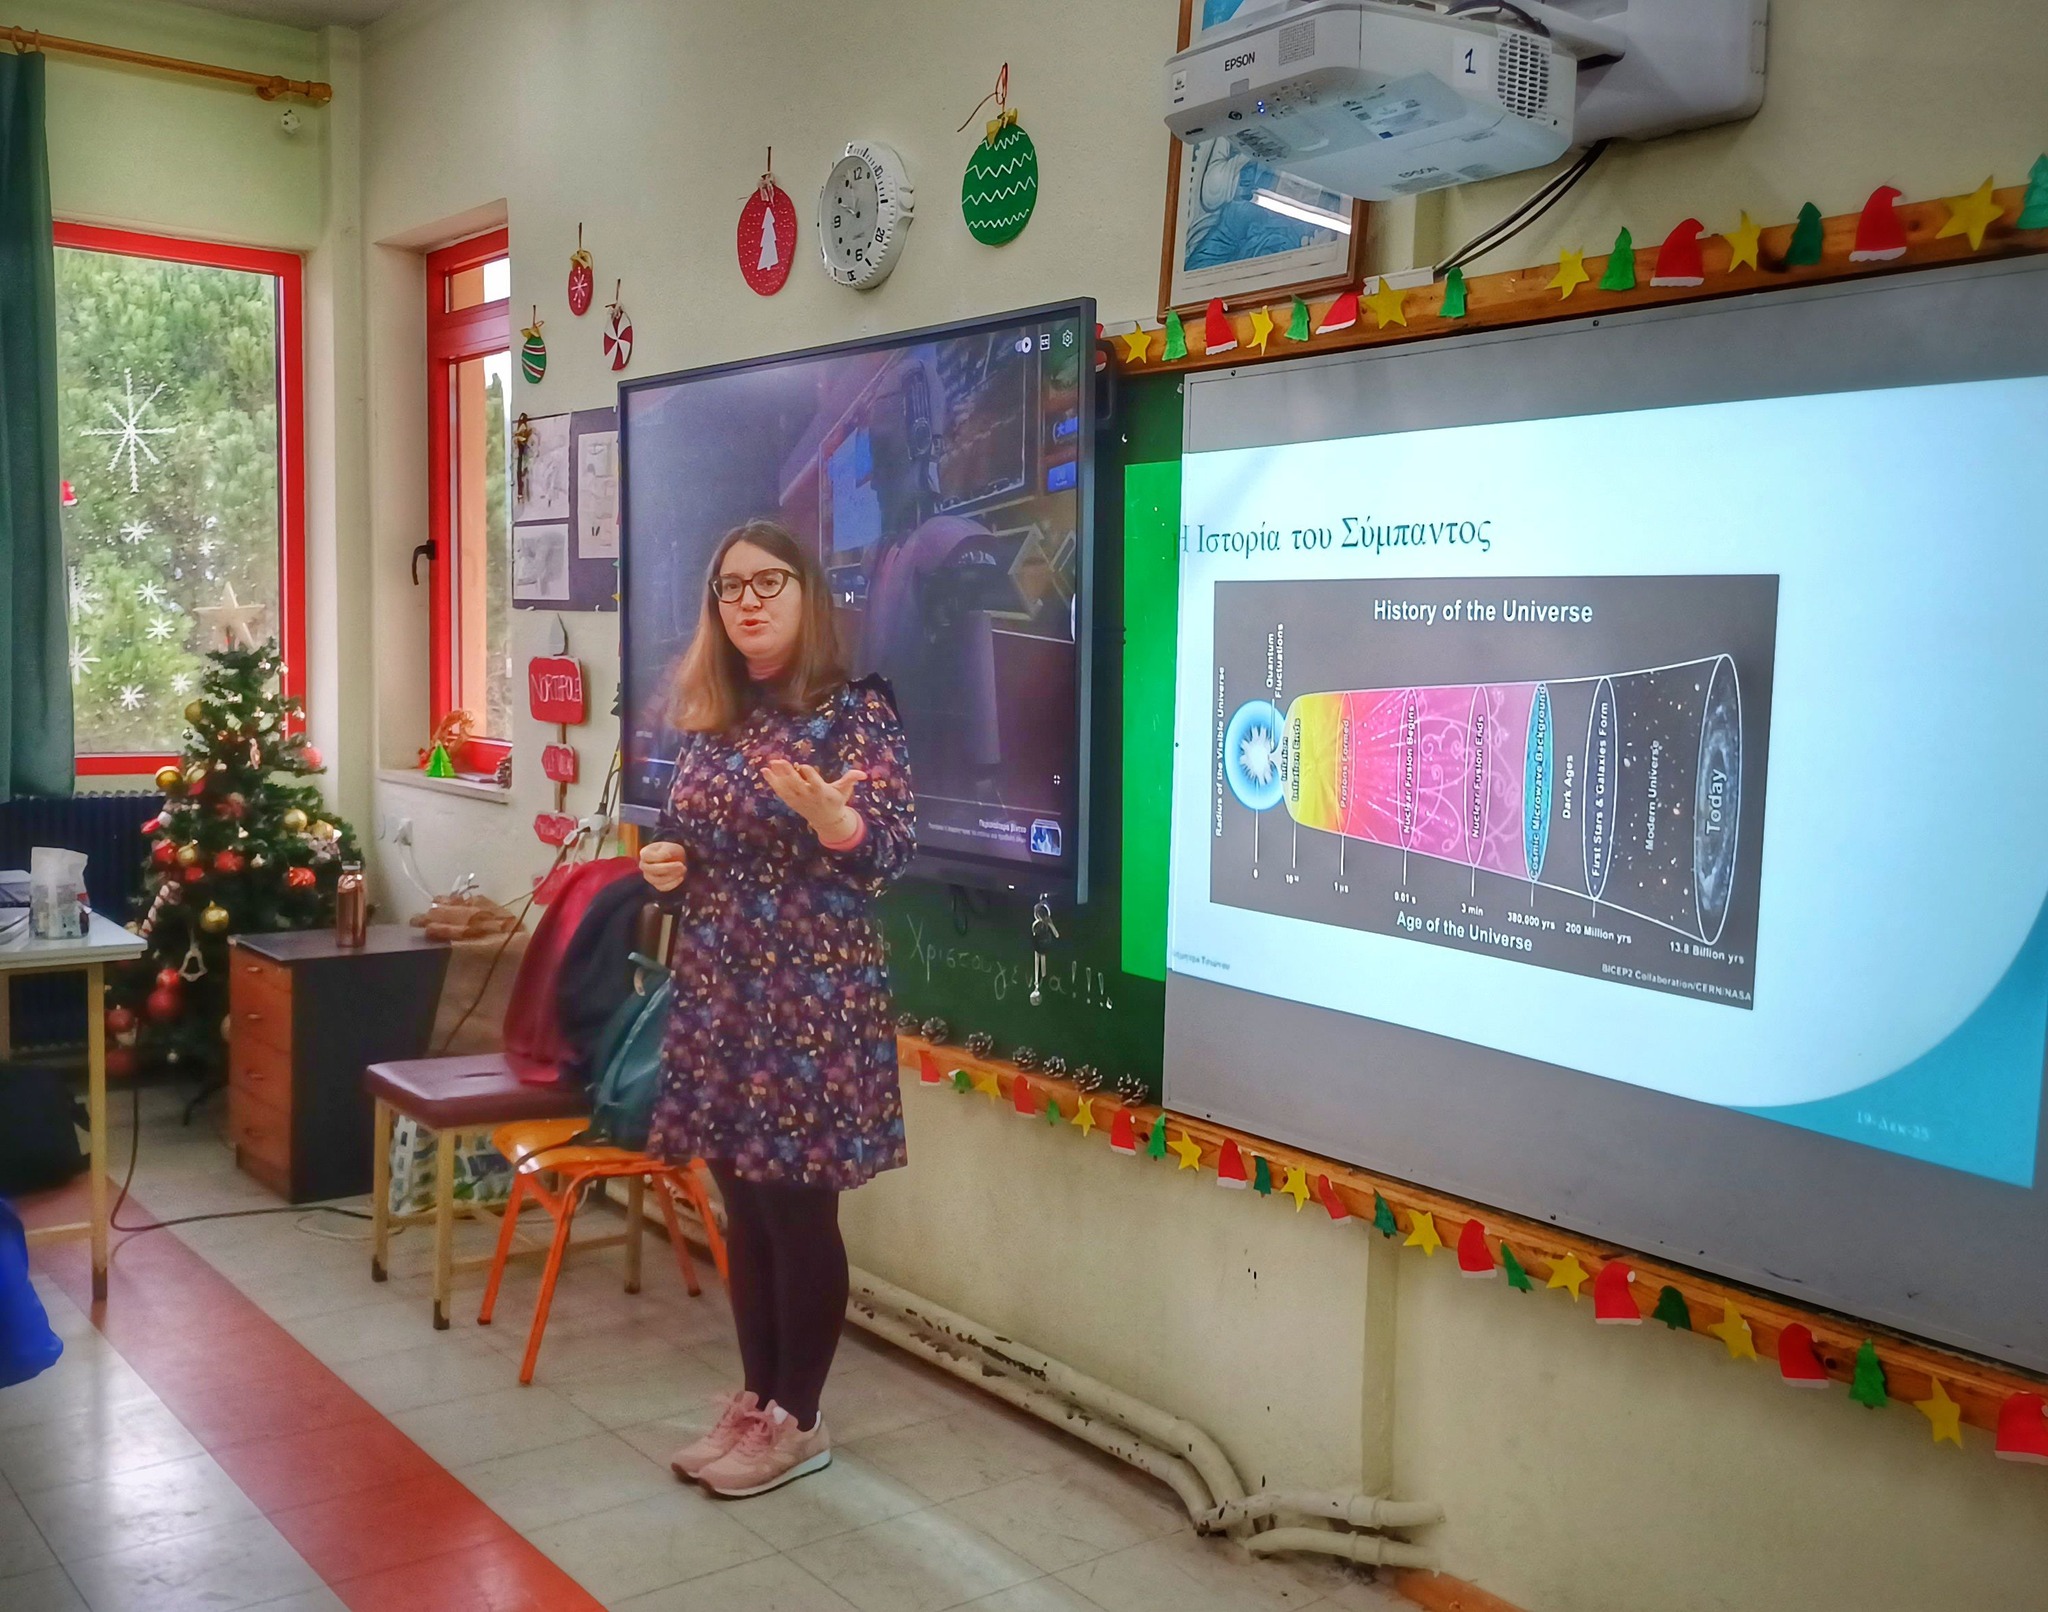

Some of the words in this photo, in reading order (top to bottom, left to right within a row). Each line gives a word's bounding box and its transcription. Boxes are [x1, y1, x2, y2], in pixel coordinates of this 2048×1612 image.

[1224, 51, 1255, 71] EPSON
[1464, 48, 1476, 74] 1
[853, 166, 863, 181] 12
[834, 215, 841, 229] 9
[875, 227, 885, 243] 20
[855, 248, 863, 262] 6
[1197, 522, 1280, 559] Ιστορία
[1291, 527, 1332, 550] του
[1341, 515, 1491, 555] Σύμπαντος
[1373, 599, 1437, 626] History
[1442, 599, 1462, 621] of
[1466, 599, 1496, 622] the
[1503, 599, 1593, 623] Universe
[1266, 633, 1274, 688] Quantum
[1275, 623, 1284, 699] Fluctuations
[1293, 718, 1301, 750] Ends
[1407, 705, 1415, 745] Begins
[1476, 715, 1484, 746] Ends
[1537, 686, 1546, 761] Background
[1599, 702, 1608, 736] Form
[1292, 752, 1300, 802] Inflation
[1405, 748, 1413, 787] Fusion
[1474, 749, 1482, 792] Fusion
[1564, 755, 1573, 787] Ages
[1596, 740, 1606, 794] Galaxies
[1648, 740, 1659, 798] Universe
[1340, 765, 1348, 808] Protons
[1533, 762, 1543, 831] Microwave
[1595, 798, 1604, 808] &
[1706, 769, 1727, 835] Today
[1404, 787, 1412, 833] Nuclear
[1472, 793, 1480, 838] Nuclear
[1563, 790, 1572, 819] Dark
[1594, 811, 1602, 844] Stars
[1645, 801, 1656, 850] Modern
[1531, 832, 1539, 879] Cosmic
[1592, 846, 1601, 877] First
[1394, 891, 1410, 903] 0.01
[1461, 903, 1466, 913] 3
[1468, 905, 1484, 916] min
[1396, 910, 1422, 932] Age
[1426, 917, 1440, 933] of
[1443, 920, 1465, 938] the
[1469, 923, 1533, 952] Universe
[1541, 919, 1556, 932] yrs
[1565, 922, 1582, 935] 200
[1584, 925, 1614, 942] Million
[1616, 933, 1632, 945] yrs
[1669, 941, 1690, 955] 13.8
[1692, 944, 1725, 961] Billion
[1727, 953, 1745, 965] yrs
[1602, 963, 1633, 979] BICEP2
